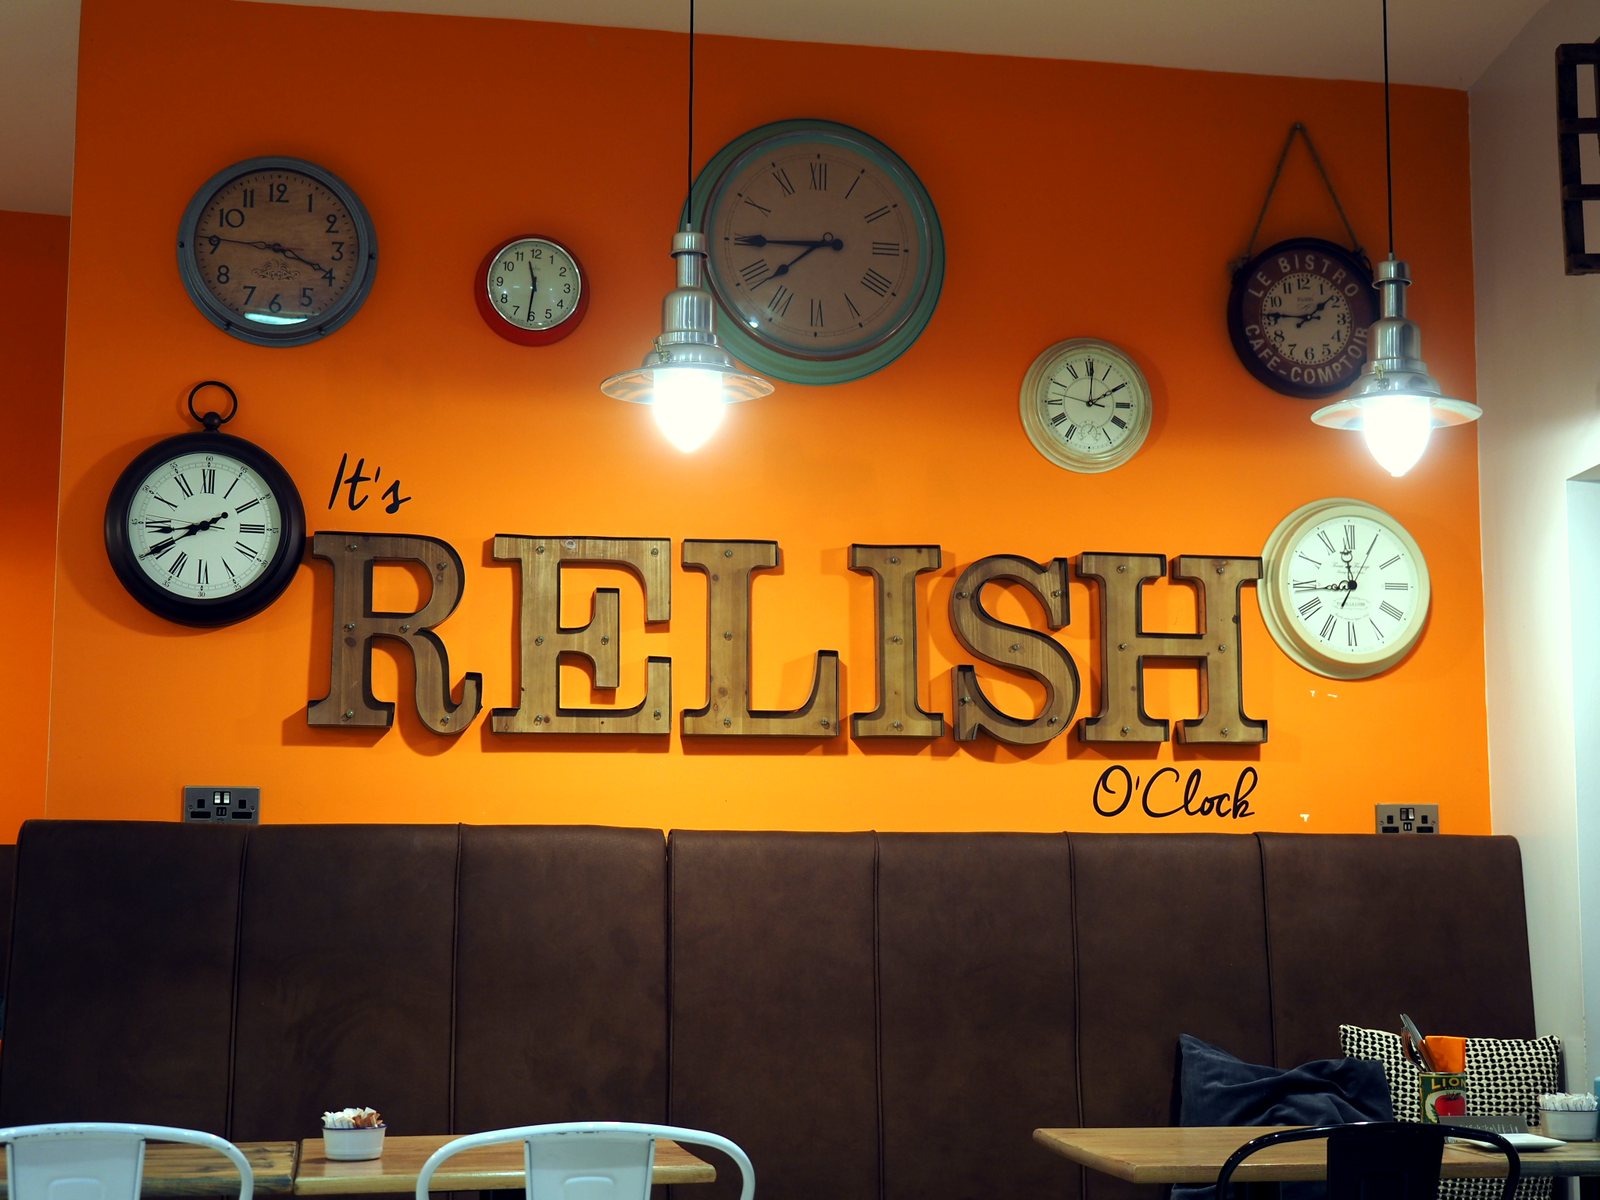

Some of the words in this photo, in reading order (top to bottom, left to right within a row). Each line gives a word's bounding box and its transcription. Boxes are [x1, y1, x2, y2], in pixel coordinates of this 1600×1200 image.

[771, 168, 795, 197] XI
[810, 163, 827, 191] XII
[243, 189, 254, 208] 11
[269, 184, 289, 202] 12
[308, 194, 313, 212] 1
[744, 196, 771, 217] X
[219, 208, 245, 228] 10
[864, 205, 891, 223] II
[326, 214, 339, 233] 2
[208, 235, 221, 255] 9
[331, 242, 343, 261] 3
[530, 249, 542, 259] 12
[872, 242, 899, 256] III
[515, 252, 524, 261] 11
[550, 255, 554, 264] 1
[217, 265, 230, 284] 8
[503, 261, 514, 271] 10
[559, 267, 566, 276] 2
[321, 268, 336, 287] 4
[496, 277, 503, 286] 9
[1248, 271, 1272, 298] LE
[1278, 254, 1359, 297] BISTRO
[1297, 278, 1311, 290] 12
[243, 286, 257, 306] 7
[301, 287, 314, 307] 5
[563, 284, 571, 293] 3
[1283, 282, 1292, 294] 11
[1319, 283, 1324, 295] 1
[269, 294, 282, 313] 6
[500, 294, 508, 304] 8
[557, 300, 563, 309] 4
[768, 285, 794, 317] VII
[844, 293, 860, 319] V
[1270, 296, 1282, 308] 10
[1331, 296, 1340, 308] 2
[513, 305, 520, 315] 7
[528, 311, 535, 321] 6
[545, 309, 552, 319] 5
[810, 299, 824, 327] VI
[1337, 313, 1346, 325] 3
[1268, 314, 1278, 326] 9
[1274, 330, 1285, 342] 8
[1331, 330, 1341, 342] 4
[1288, 344, 1297, 356] 7
[1304, 348, 1315, 360] 6
[1322, 344, 1331, 355] 5
[174, 473, 194, 500] XI
[200, 469, 216, 494] XII
[328, 452, 412, 514] It's
[154, 492, 177, 512] X
[235, 498, 260, 514] II
[240, 523, 265, 534] III
[1344, 525, 1355, 550] XII
[1317, 530, 1336, 555] XI
[168, 551, 188, 578] VII
[197, 559, 209, 584] VI
[221, 556, 235, 579] V
[1379, 555, 1401, 570] II
[1385, 582, 1408, 590] III
[1298, 597, 1323, 621] VIII
[1320, 614, 1337, 641] VII
[1348, 621, 1358, 646] VI
[1369, 617, 1384, 640] V
[307, 530, 1268, 745] RELISH
[1092, 765, 1258, 819] O'Clock
